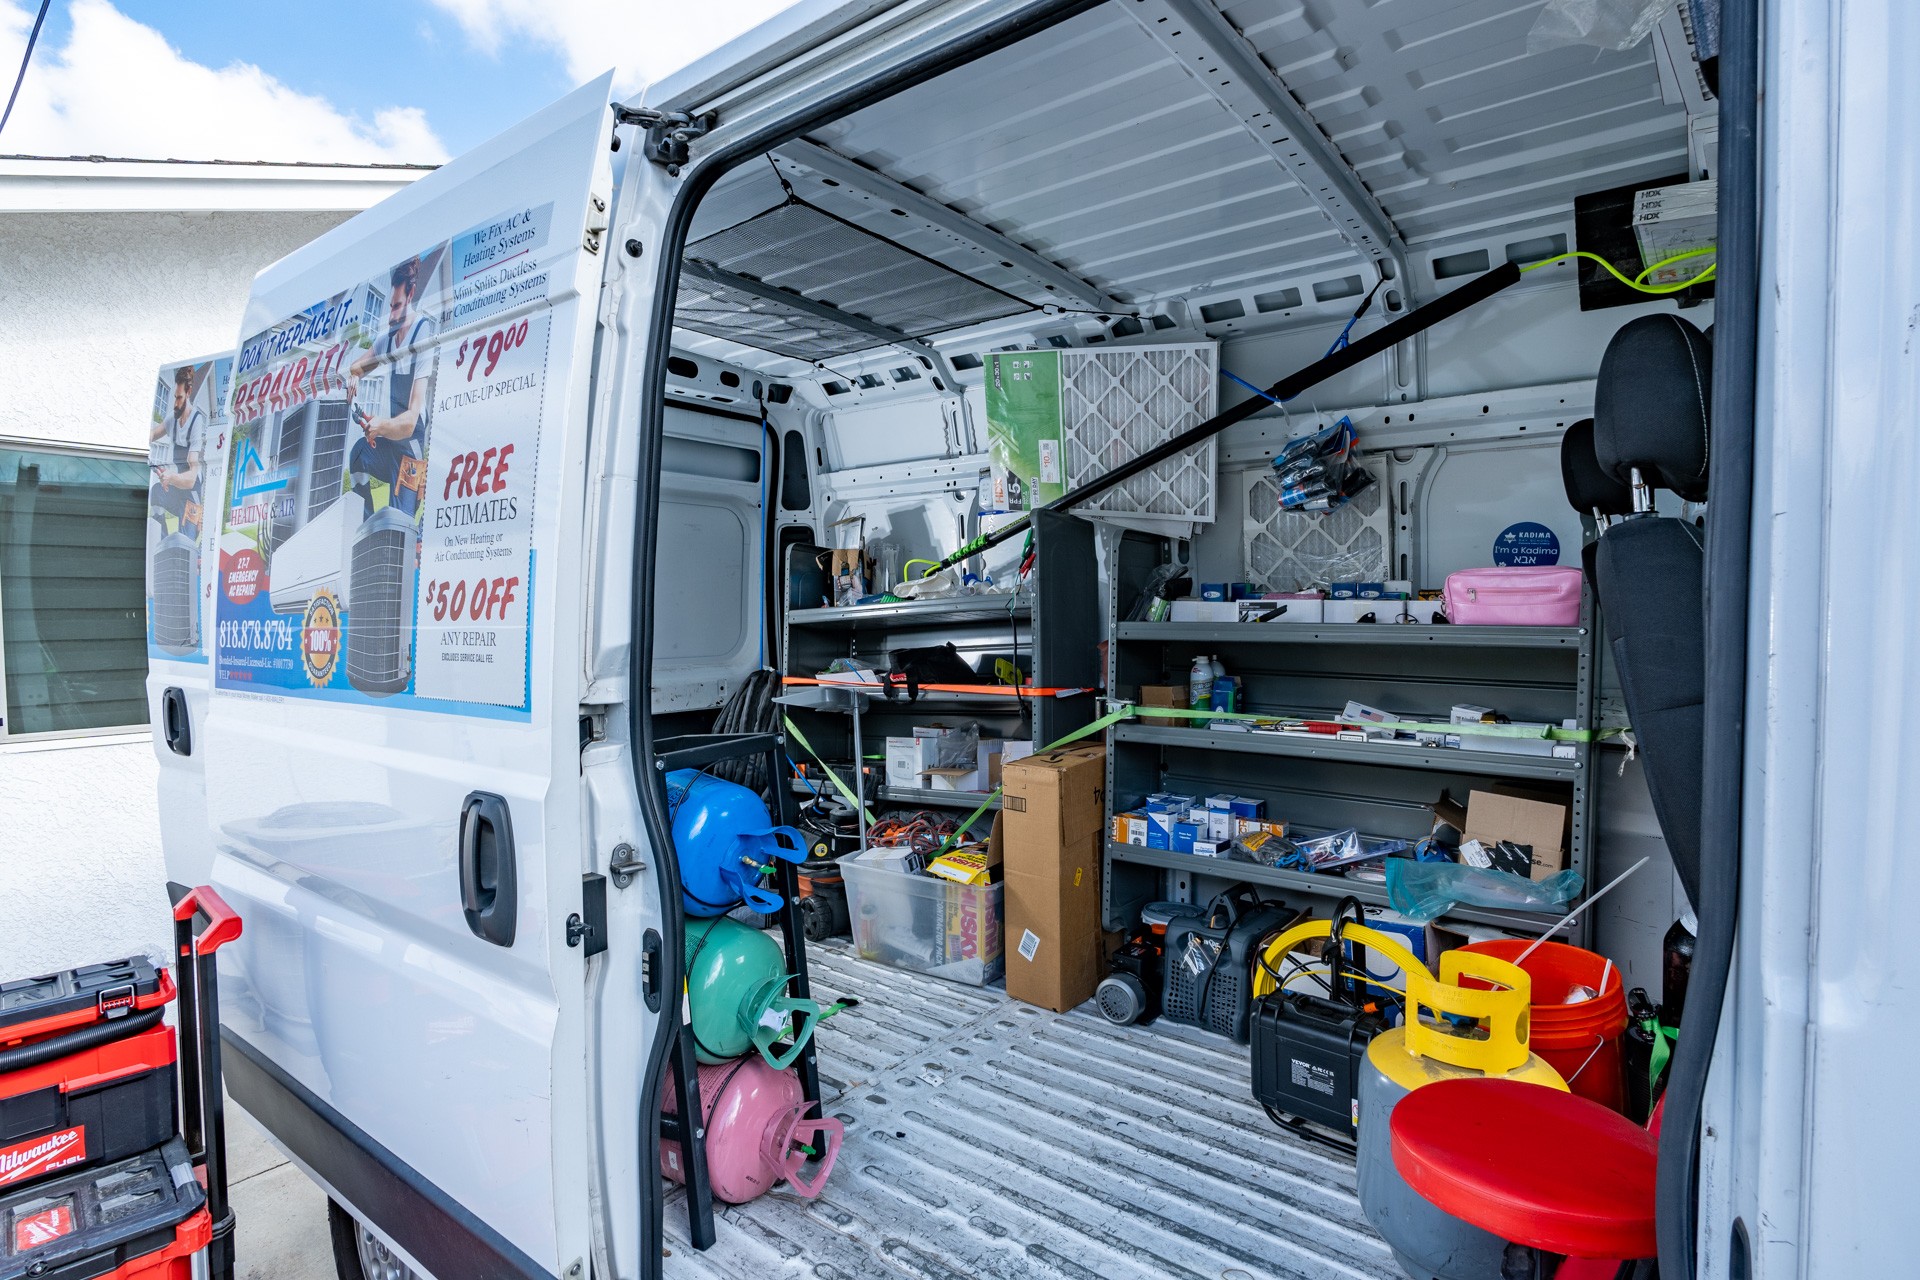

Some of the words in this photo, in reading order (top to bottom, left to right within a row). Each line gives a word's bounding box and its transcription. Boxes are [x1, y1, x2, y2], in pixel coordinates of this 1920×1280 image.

[1641, 188, 1661, 198] HDX
[1639, 212, 1660, 221] HDX
[1641, 201, 1661, 210] HDX
[474, 230, 487, 246] We
[489, 223, 503, 240] Fix
[505, 213, 521, 232] AC
[522, 208, 531, 224] &
[463, 245, 496, 268] Heating
[498, 227, 536, 254] Systems
[453, 282, 473, 301] Mini
[474, 274, 497, 295] Splits
[500, 259, 537, 284] Ductless
[439, 307, 453, 323] Air
[454, 288, 507, 317] Conditioning
[509, 272, 547, 298] Systems
[239, 334, 278, 373] DON'T
[274, 307, 335, 357] REPLACE
[333, 299, 358, 330] IT...
[234, 356, 309, 425] REPAIR
[310, 340, 349, 399] IT!
[439, 397, 453, 413] AC
[453, 384, 494, 409] TUNE-UP
[495, 373, 536, 397] SPECIAL
[443, 443, 514, 501] FREE
[231, 502, 268, 526] HEATING
[270, 502, 278, 519] &
[278, 498, 295, 517] AIR
[435, 496, 518, 529] ESTIMATES
[444, 536, 454, 547] On
[455, 535, 468, 546] New
[470, 532, 494, 545] Heating
[495, 533, 503, 542] or
[1494, 546, 1510, 554] I'm
[1520, 546, 1558, 555] Kadima
[434, 552, 444, 563] Air
[445, 548, 484, 562] Conditioning
[485, 546, 512, 560] Systems
[1513, 555, 1537, 564] אבא
[228, 570, 259, 583] EMERGENCY
[229, 585, 236, 597] AC
[426, 578, 466, 622] $50
[470, 576, 519, 622] OFF
[220, 616, 293, 652] 818.878.8784
[310, 630, 332, 652] 100%
[440, 632, 461, 646] ANY
[462, 631, 497, 647] REPAIR
[441, 653, 459, 662] EXCLUDES
[460, 653, 475, 662] SERVICE
[475, 654, 485, 663] CALL
[219, 669, 230, 680] YELP
[936, 899, 944, 944] CONTRACTOR
[961, 887, 978, 959] HUSKY
[936, 945, 944, 966] PACK
[46, 1155, 85, 1171] FUEL
